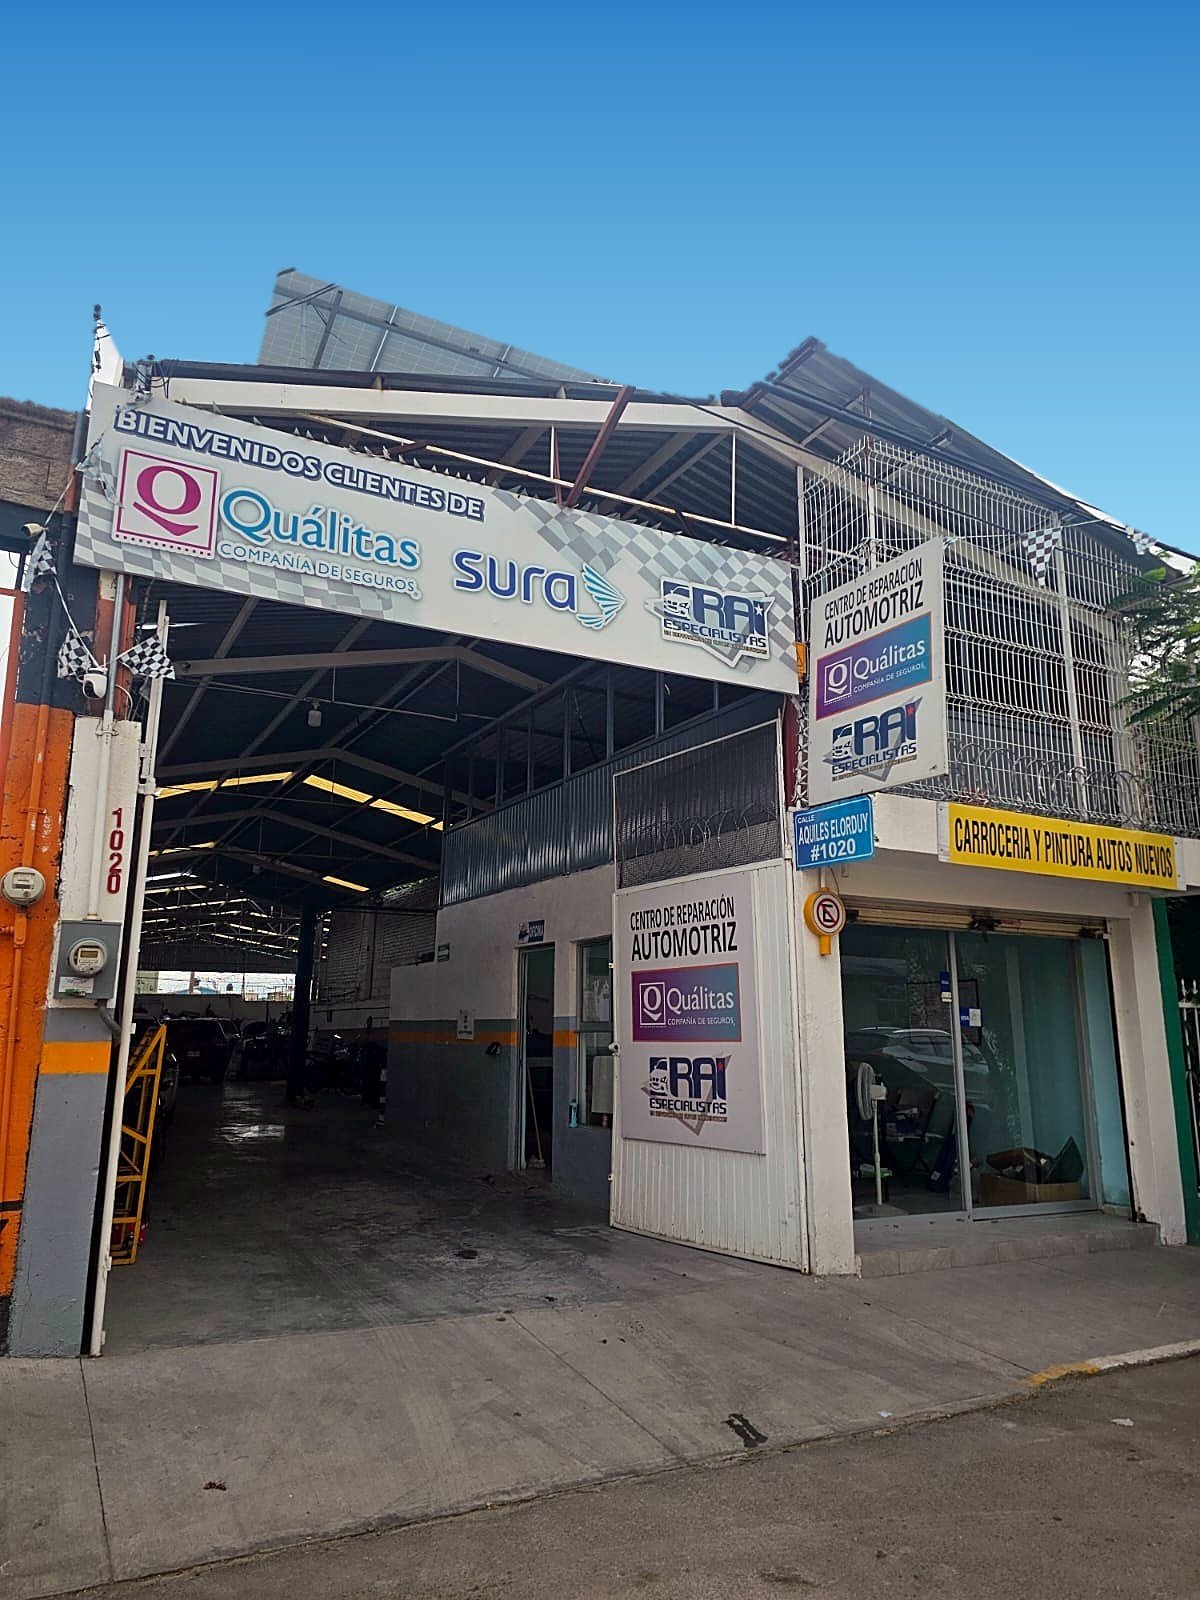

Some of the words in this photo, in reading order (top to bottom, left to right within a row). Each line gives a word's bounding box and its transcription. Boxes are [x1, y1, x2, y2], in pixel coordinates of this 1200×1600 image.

[114, 410, 321, 480] BIENVENIDOS
[324, 462, 445, 511] CLIENTES
[448, 491, 485, 522] DE
[132, 465, 202, 537] Q
[222, 489, 419, 568] Quálitas
[318, 562, 339, 577] DE
[344, 568, 415, 592] SEGUROS
[454, 551, 577, 612] sura
[824, 591, 855, 621] CENTRO
[856, 585, 867, 606] DE
[868, 557, 922, 600] REPARACIÓN
[663, 618, 767, 648] ESPECIALISTAS
[824, 580, 924, 649] AUTOMOTRIZ
[853, 640, 925, 680] Quálitas
[832, 743, 917, 775] ESPECIALISTAS
[797, 814, 815, 824] CALLE
[798, 821, 830, 846] AQUILES
[830, 812, 869, 838] ELORDUY
[106, 807, 124, 895] 1020
[810, 838, 856, 862] #1020
[954, 817, 1032, 860] CARROCERIA
[1033, 829, 1041, 862] Y
[1045, 831, 1094, 868] PINTURA
[1097, 838, 1133, 873] AUTOS
[1134, 842, 1174, 879] NUEVOS
[630, 908, 662, 931] CENTRO
[663, 906, 675, 927] DE
[677, 893, 735, 925] REPARACIÓN
[631, 921, 738, 962] AUTOMOTRIZ
[666, 986, 734, 1014] Quálitas
[650, 1098, 727, 1115] ESPECIALISTAS
